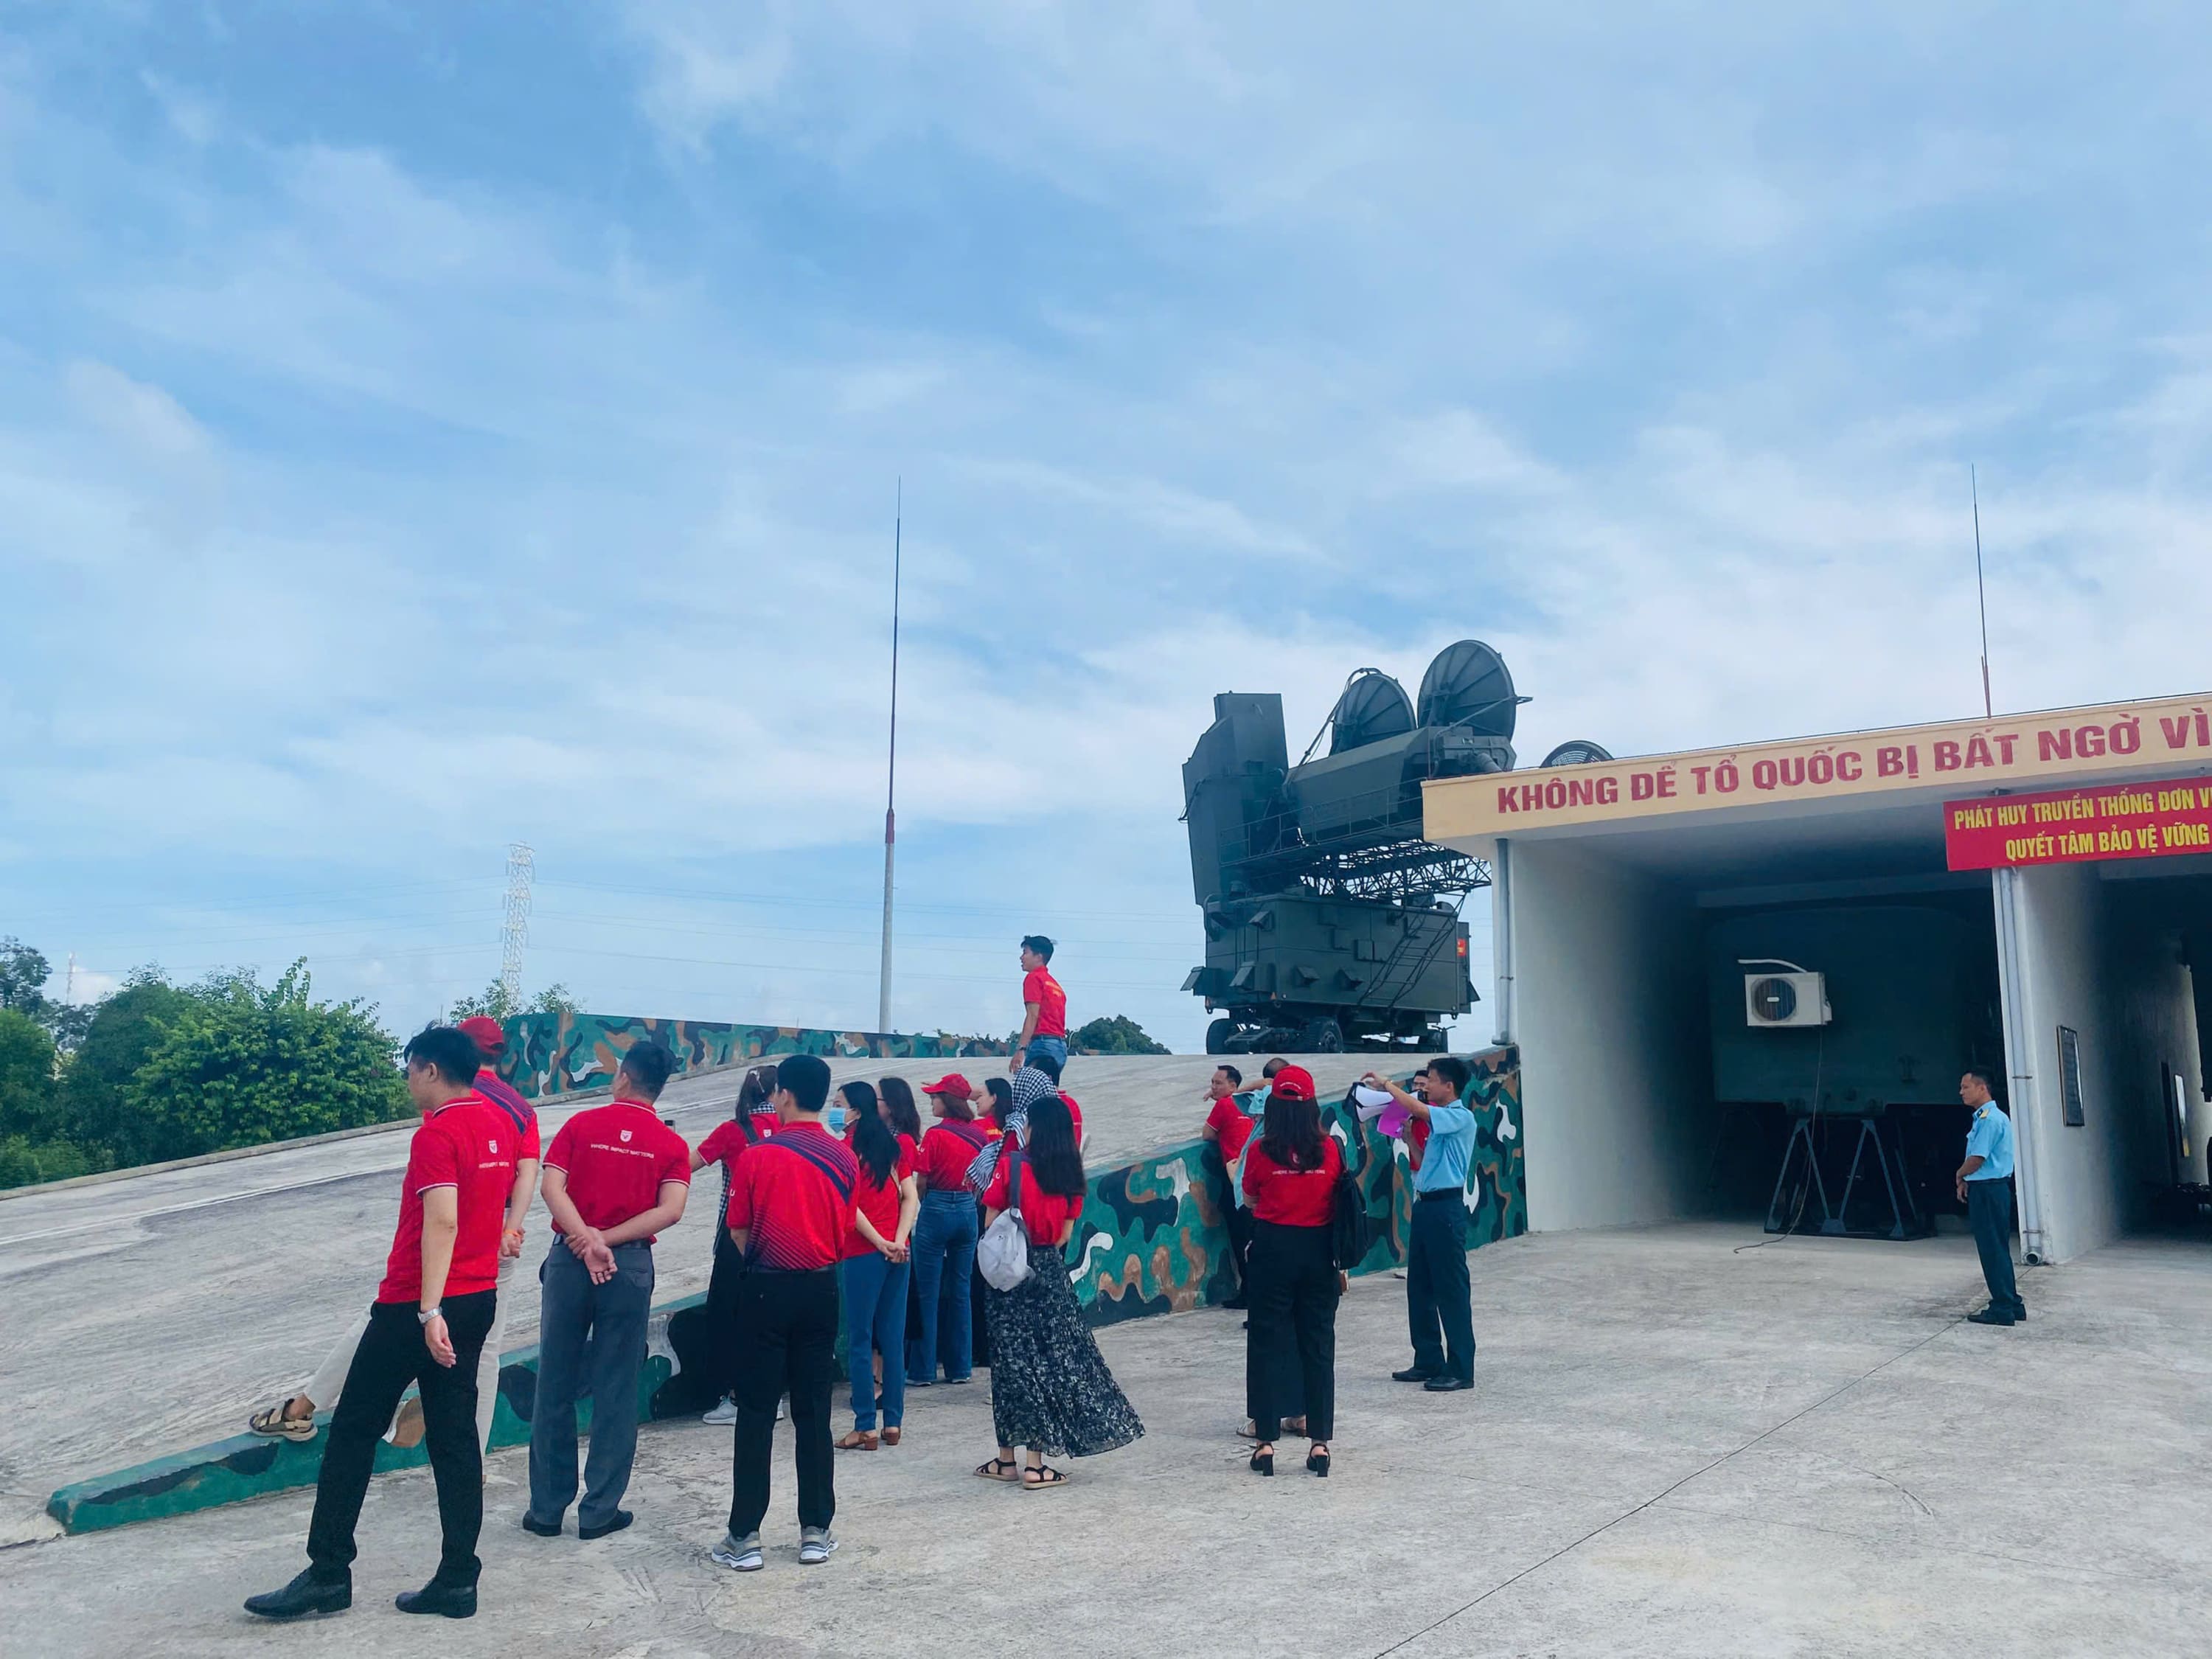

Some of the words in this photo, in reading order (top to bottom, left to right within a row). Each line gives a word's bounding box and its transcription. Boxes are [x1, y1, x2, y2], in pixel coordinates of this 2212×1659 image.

[1498, 776, 1618, 814] KHÔNG
[1690, 754, 1739, 794] TỔ
[1752, 745, 1863, 790] QUỐC
[1877, 745, 1919, 779] BỊ
[1933, 728, 2019, 771] BẤT
[2037, 713, 2141, 762] NGỜ
[2159, 707, 2211, 749] VÌ
[1954, 804, 1993, 830] PHÁT
[1997, 804, 2027, 826] HUY
[2031, 793, 2094, 823] TRUYỀN
[2098, 787, 2154, 817] THỐNG
[2158, 788, 2195, 812] ĐƠN
[2006, 830, 2054, 862] QUYẾT
[2058, 830, 2094, 855] TÂM
[2098, 824, 2132, 852] BẢO
[2136, 824, 2158, 853] VỆ
[2162, 821, 2210, 847] VỮNG
